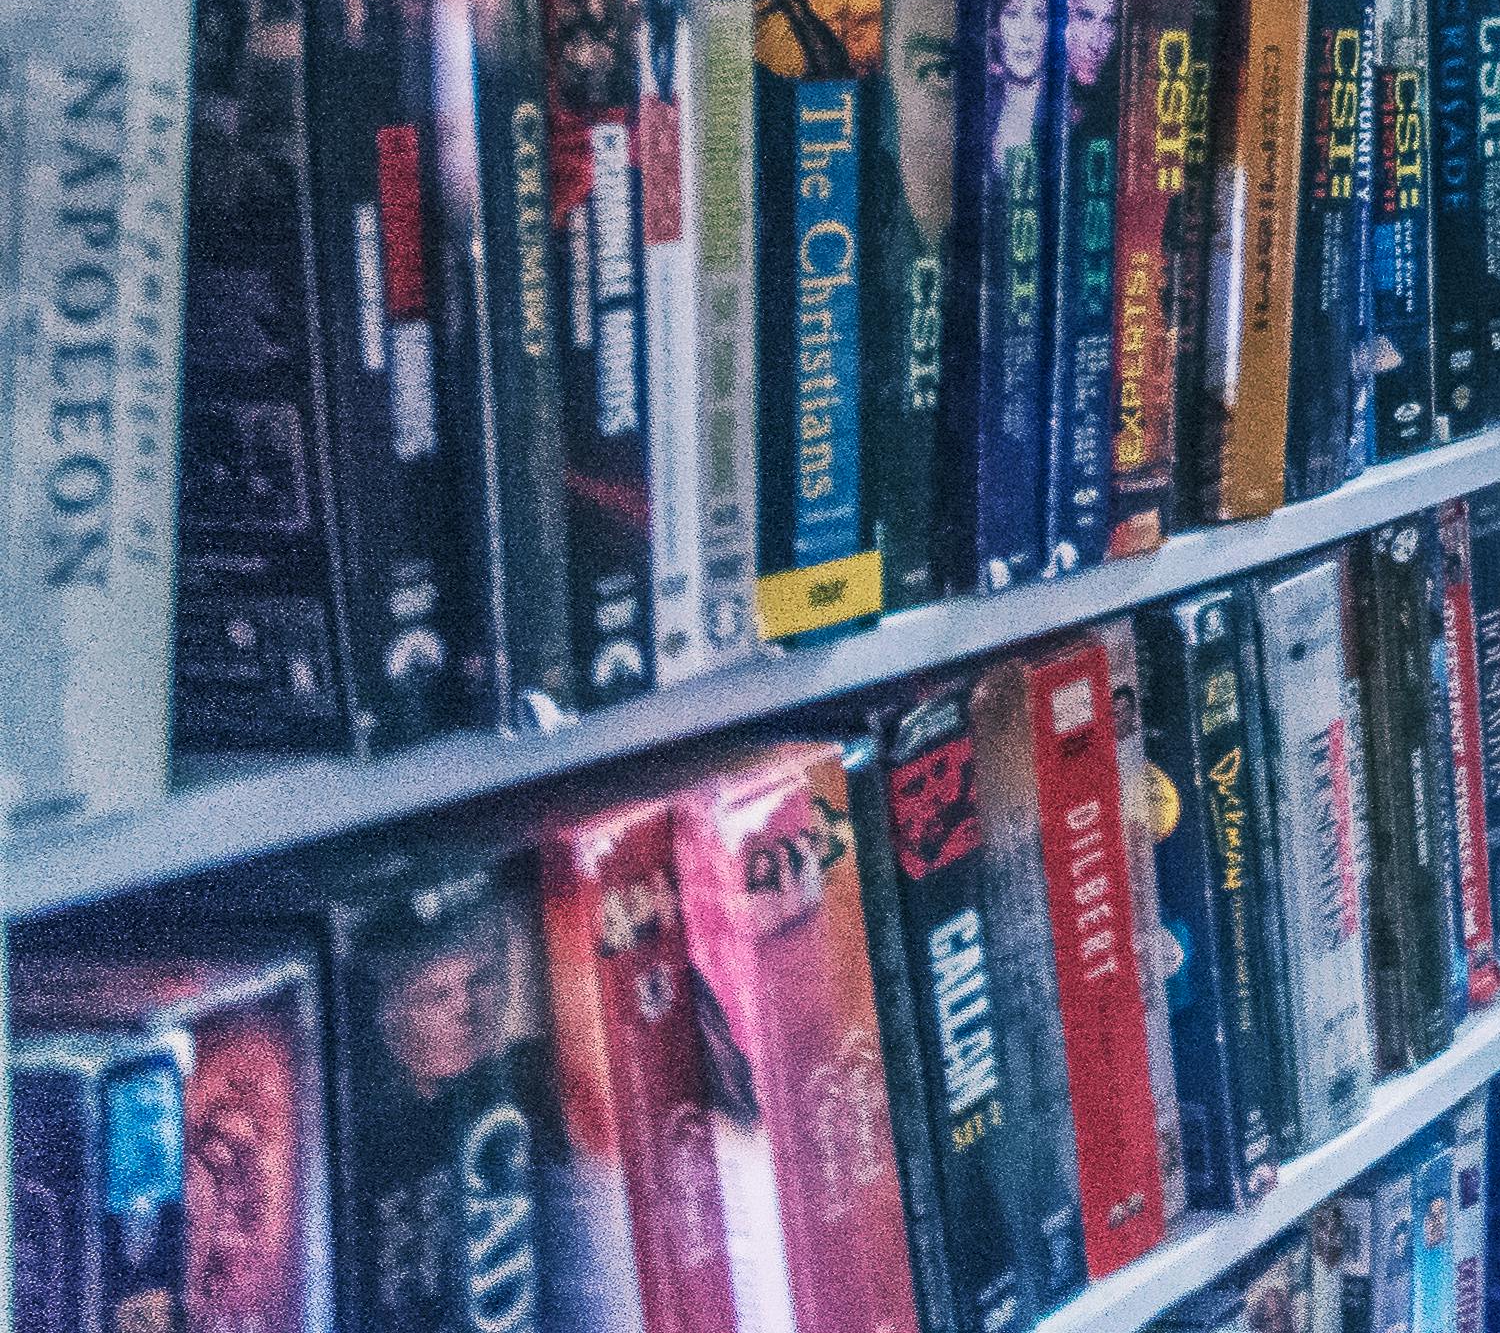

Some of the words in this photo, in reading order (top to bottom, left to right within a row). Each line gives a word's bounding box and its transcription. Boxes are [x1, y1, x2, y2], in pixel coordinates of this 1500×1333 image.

[800, 92, 854, 197] The
[1156, 30, 1189, 191] CSI:
[47, 63, 124, 590] NAPOLEON
[800, 218, 857, 497] Christians
[1065, 799, 1122, 981] DILBERT
[928, 910, 1005, 1112] CALLAN
